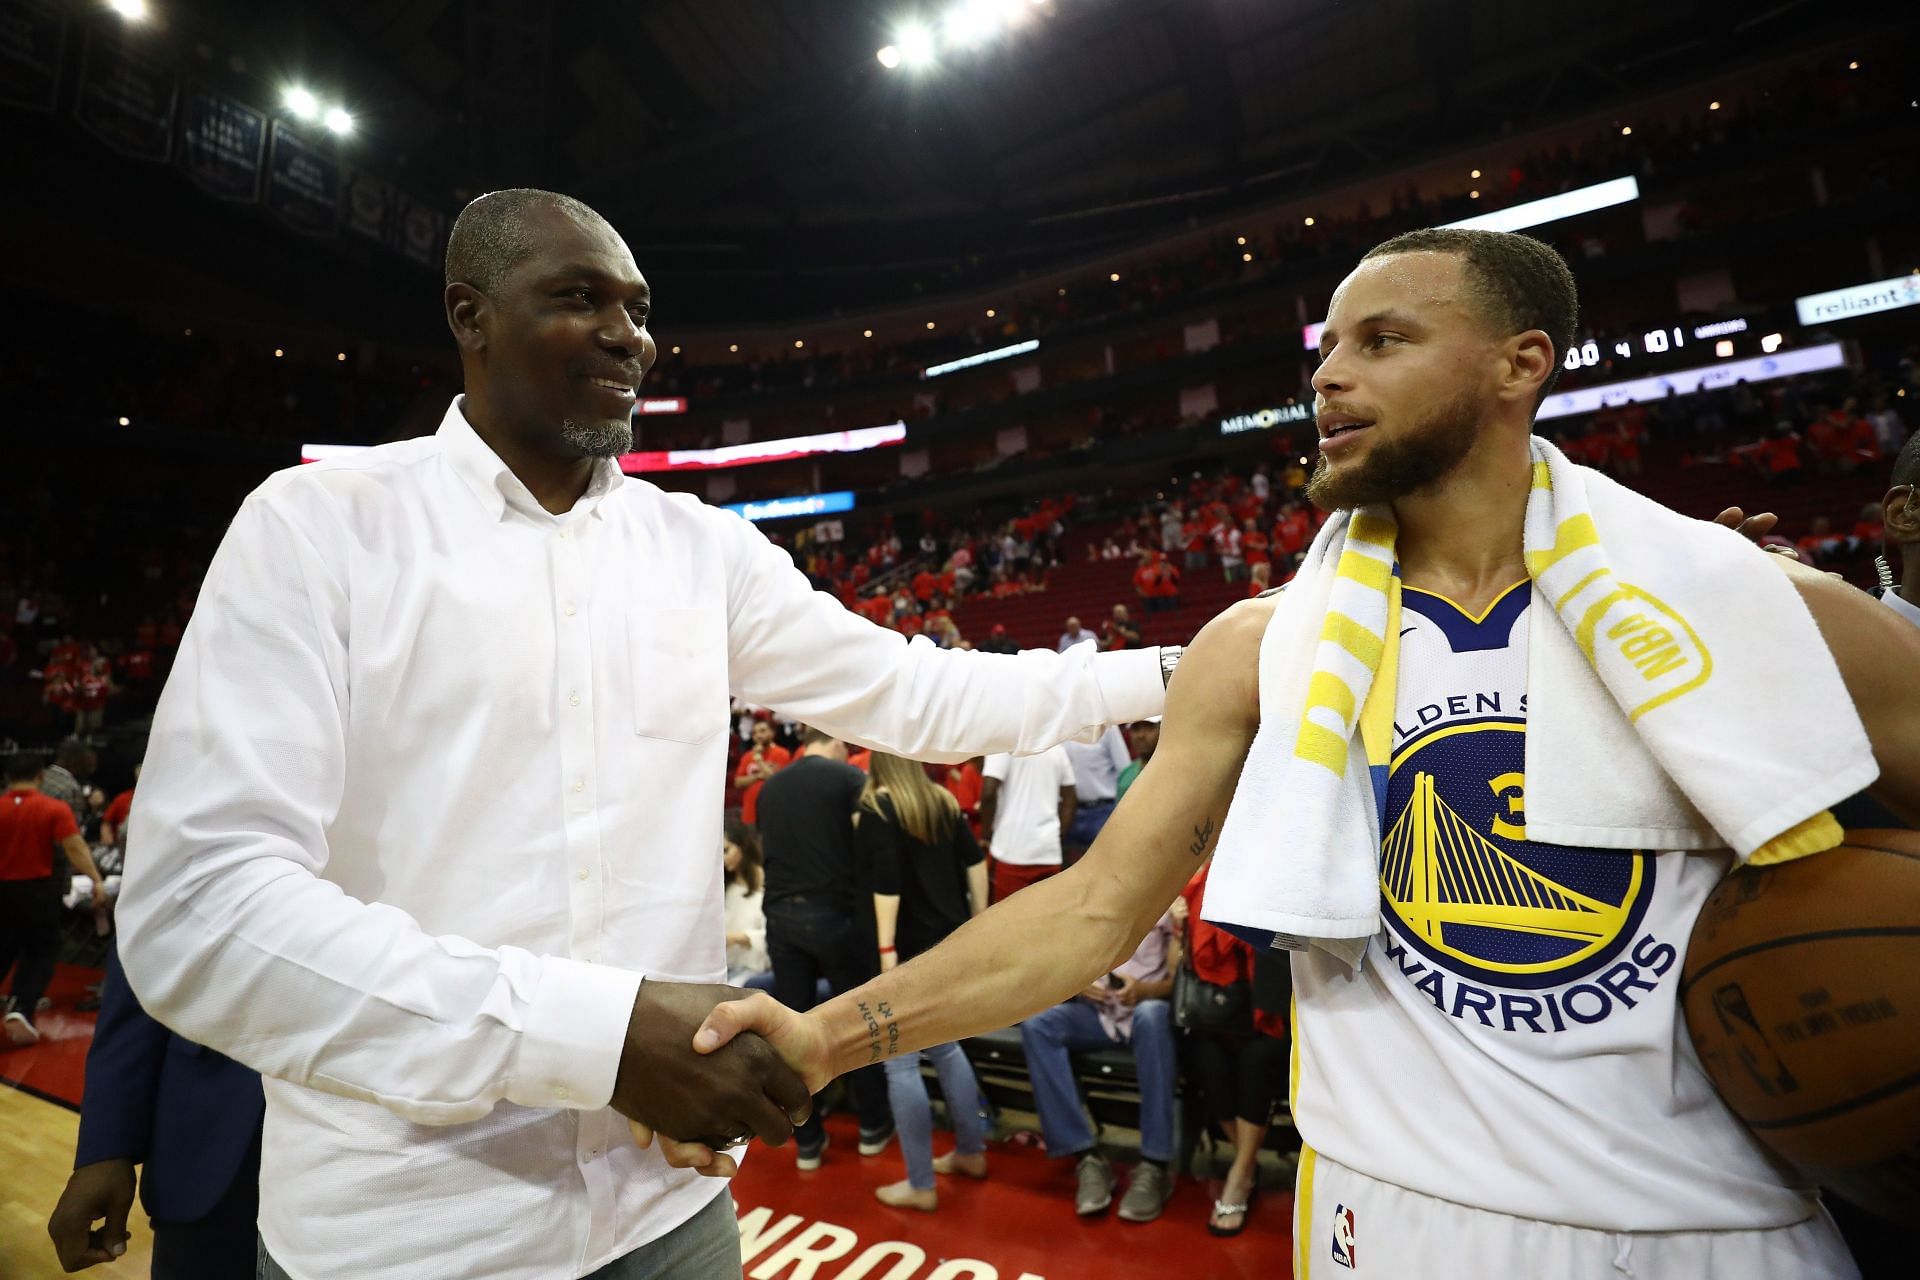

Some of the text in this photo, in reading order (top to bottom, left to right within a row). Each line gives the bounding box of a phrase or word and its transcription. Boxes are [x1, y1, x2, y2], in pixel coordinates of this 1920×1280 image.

[1815, 289, 1899, 316] reliant
[1615, 342, 1631, 358] 4
[1220, 403, 1310, 434] MEMORIAL
[1606, 613, 1688, 681] NBA
[1393, 691, 1501, 740] LDEN
[1384, 925, 1677, 1034] WARRIORS
[1333, 1251, 1349, 1266] NBA
